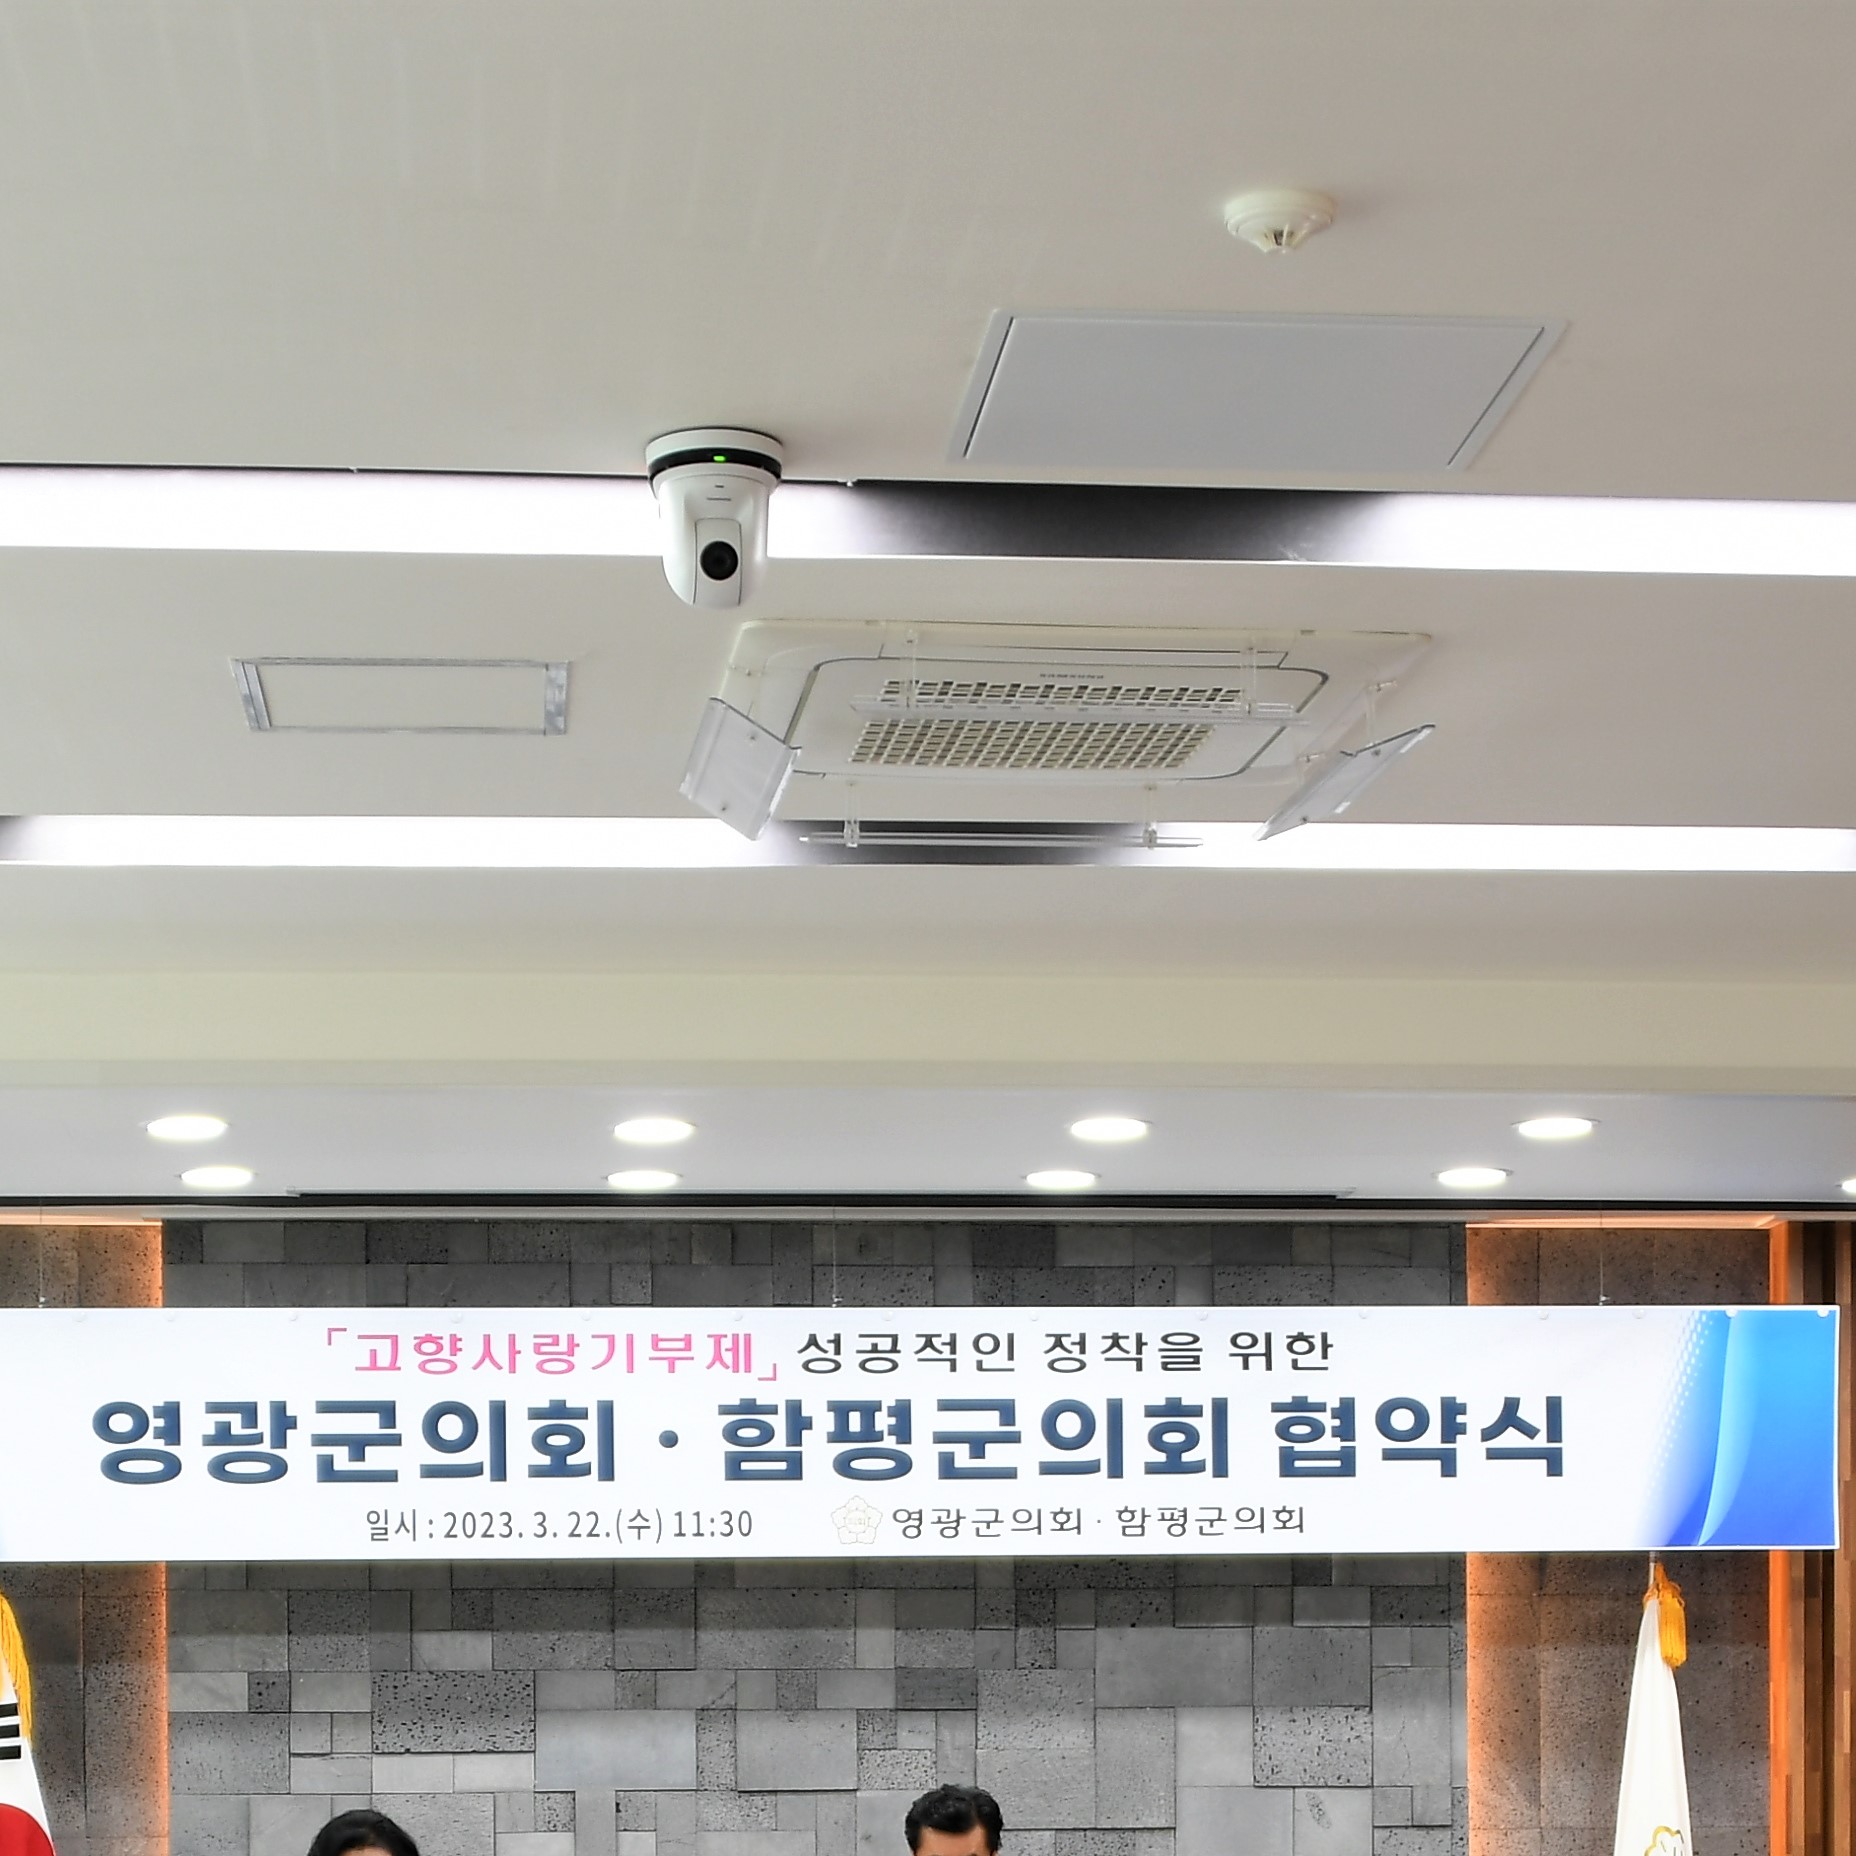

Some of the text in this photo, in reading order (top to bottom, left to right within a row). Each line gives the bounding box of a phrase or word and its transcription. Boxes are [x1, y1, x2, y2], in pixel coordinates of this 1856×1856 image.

[797, 1332, 1015, 1375] 성공적인
[1044, 1331, 1203, 1374] 정착을
[1229, 1331, 1333, 1372] 위한
[1270, 1395, 1564, 1479] 협약식
[673, 1510, 753, 1538] 11:30
